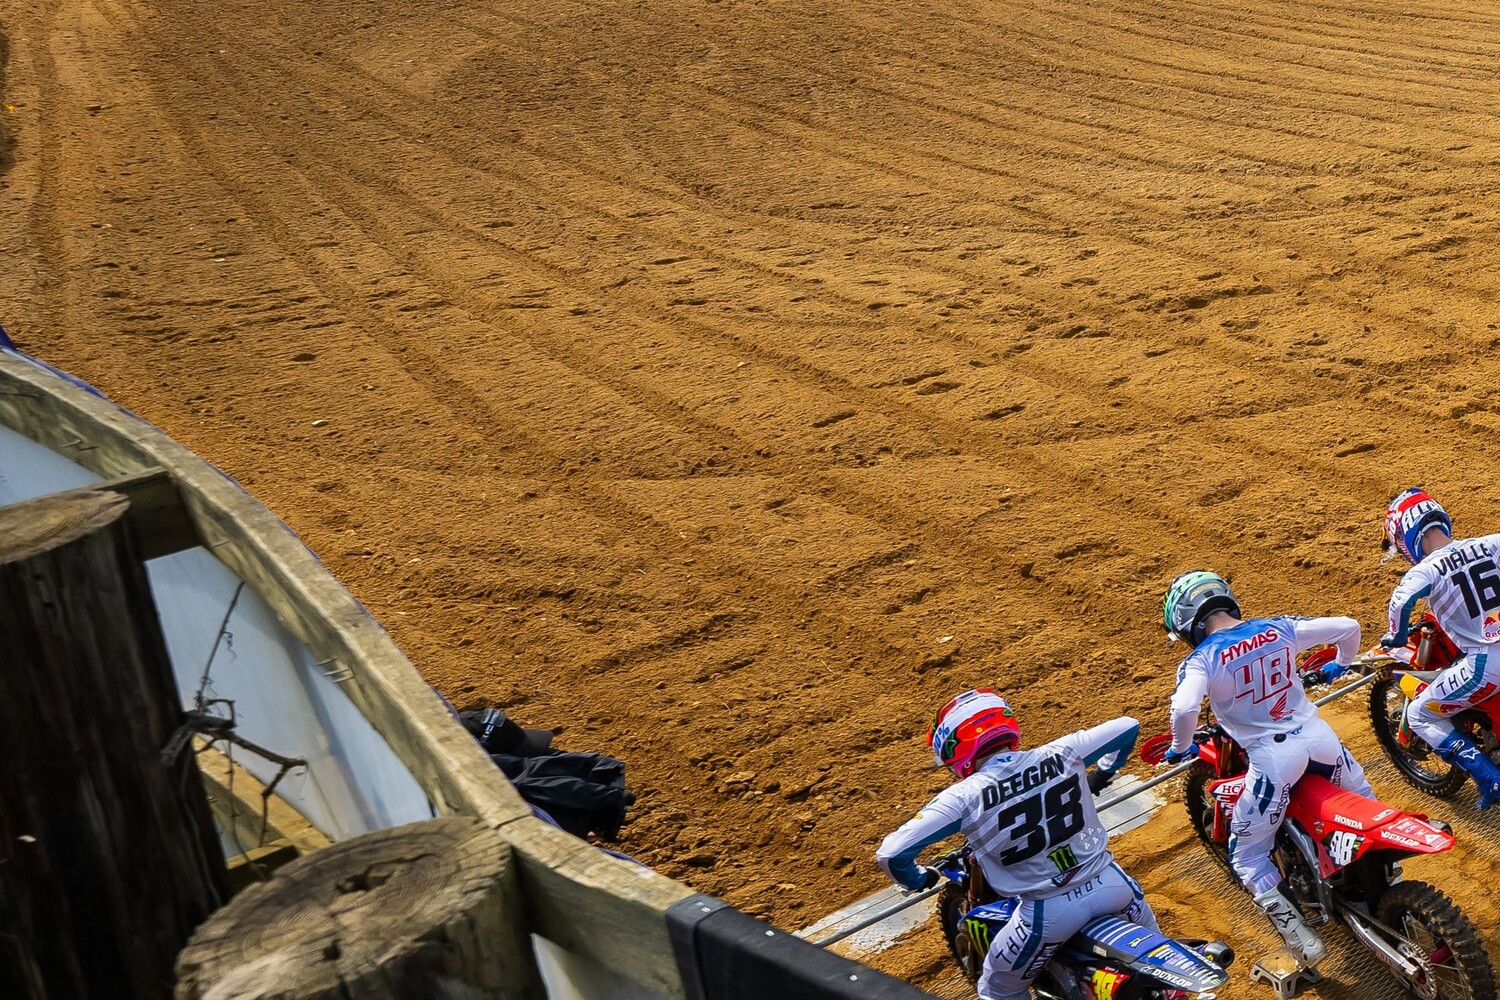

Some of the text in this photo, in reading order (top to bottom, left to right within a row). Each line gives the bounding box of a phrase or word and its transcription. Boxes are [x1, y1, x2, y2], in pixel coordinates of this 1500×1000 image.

[1433, 543, 1492, 576] VIALLE
[1220, 628, 1278, 666] HYMAS
[1233, 647, 1293, 705] 48
[982, 753, 1065, 811] DEEGAN
[997, 774, 1086, 867] 38
[1334, 814, 1363, 830] HONDA
[1329, 830, 1357, 866] 48
[1381, 830, 1420, 848] DUNLOP
[1063, 876, 1104, 902] THOR
[1151, 967, 1193, 988] DUNLOP
